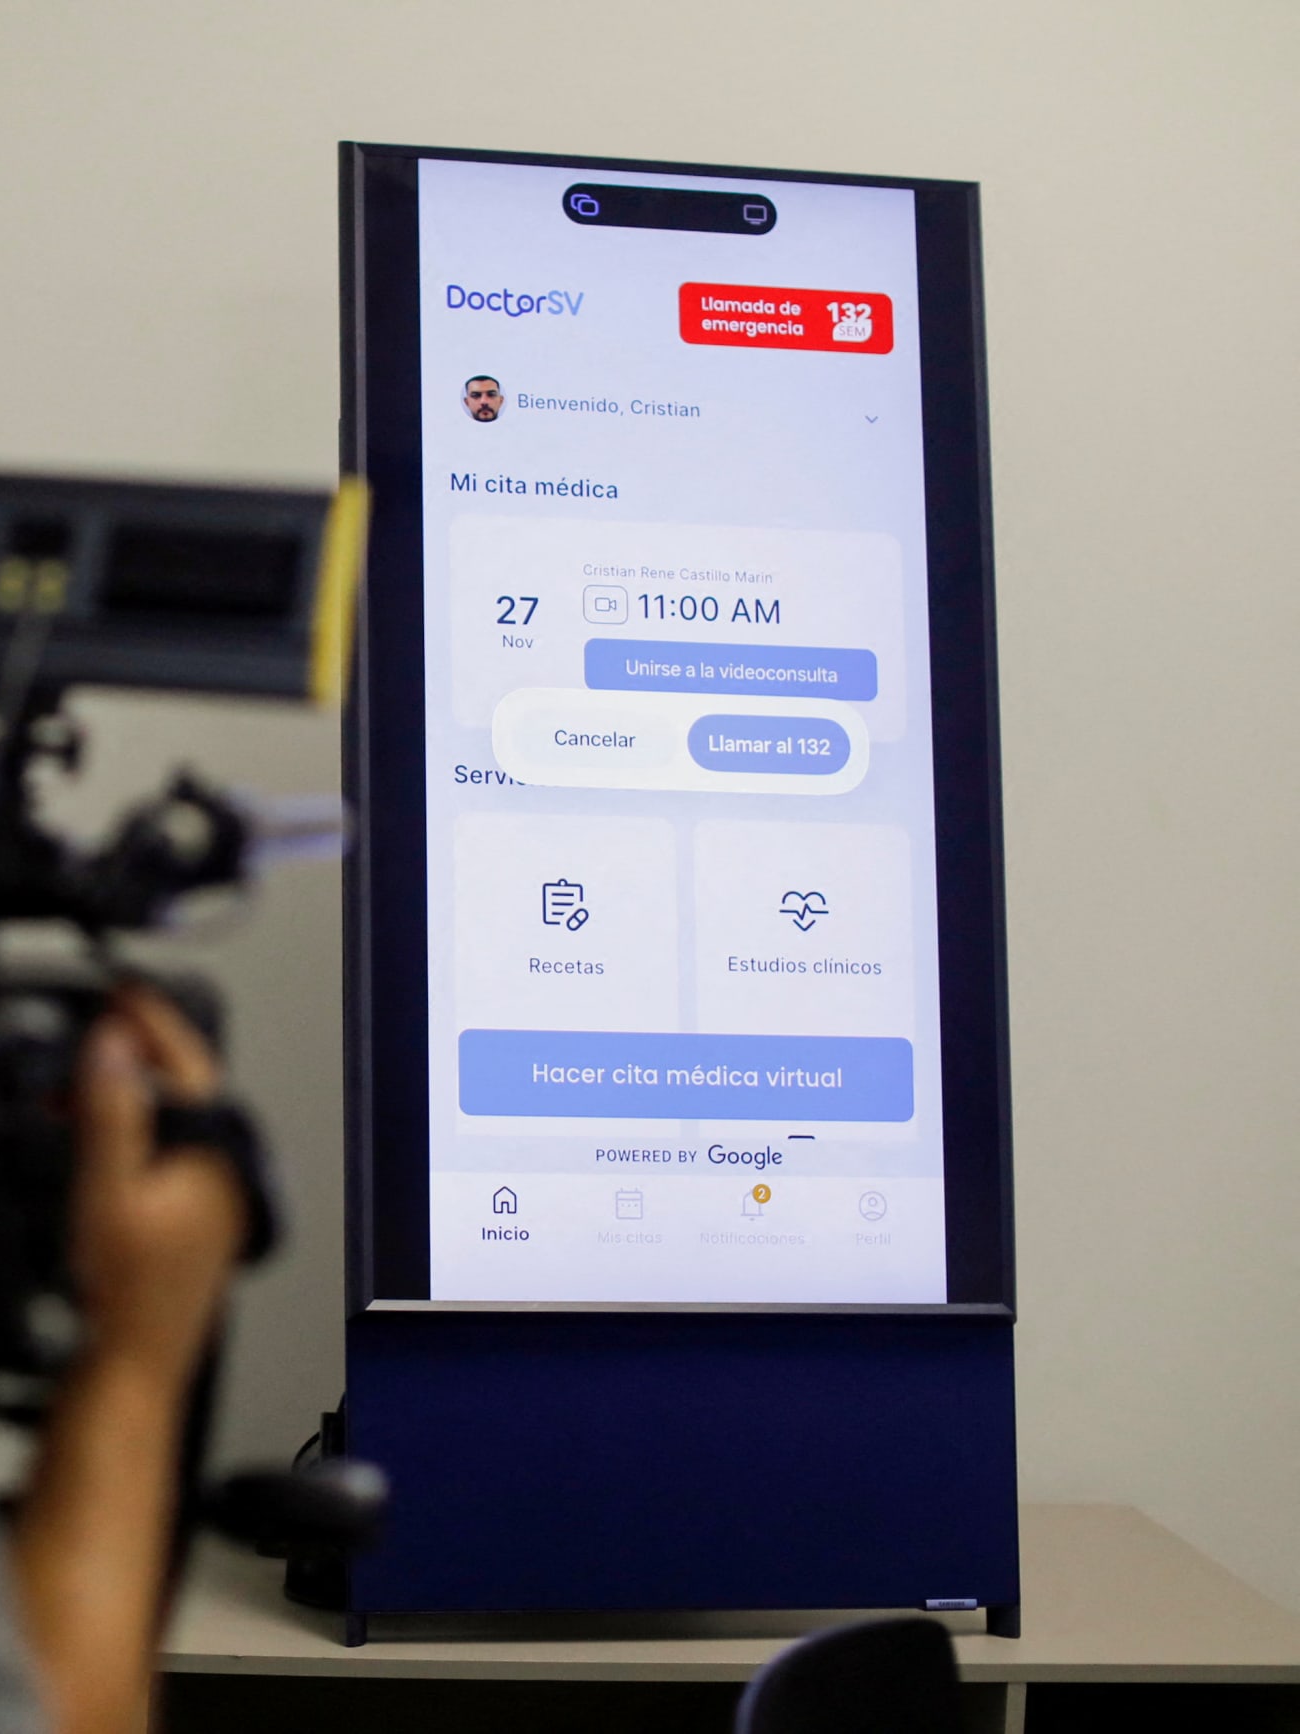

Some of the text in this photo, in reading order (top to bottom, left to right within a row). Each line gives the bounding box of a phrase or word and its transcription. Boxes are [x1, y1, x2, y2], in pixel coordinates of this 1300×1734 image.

[446, 284, 584, 318] DoctorSV
[701, 296, 802, 316] Llamada de
[826, 302, 872, 323] 132
[701, 317, 804, 338] emergencia
[839, 325, 866, 337] SEM
[518, 393, 701, 418] Bienvenido, Cristian
[451, 473, 619, 500] Mi cita médica
[583, 564, 636, 578] Cristian
[640, 566, 675, 580] Rene
[679, 568, 730, 583] Castillo
[496, 596, 539, 626] 27
[638, 594, 781, 625] 11:00 AM
[502, 635, 534, 649] Nov
[625, 659, 838, 684] Unirse a la videoconsulta
[554, 730, 636, 749] Cancelar
[708, 735, 831, 757] Llamar al 132
[529, 957, 605, 975] Recetas
[728, 956, 883, 976] Estudios clínicos
[532, 1062, 843, 1089] Hacer cita médica virtual
[596, 1145, 783, 1170] POWERED BY Google
[756, 1187, 768, 1201] 2
[481, 1225, 530, 1242] Inicio
[597, 1231, 662, 1245] Mis citas
[700, 1231, 805, 1246] Notificaciones
[856, 1232, 891, 1246] Perfil
